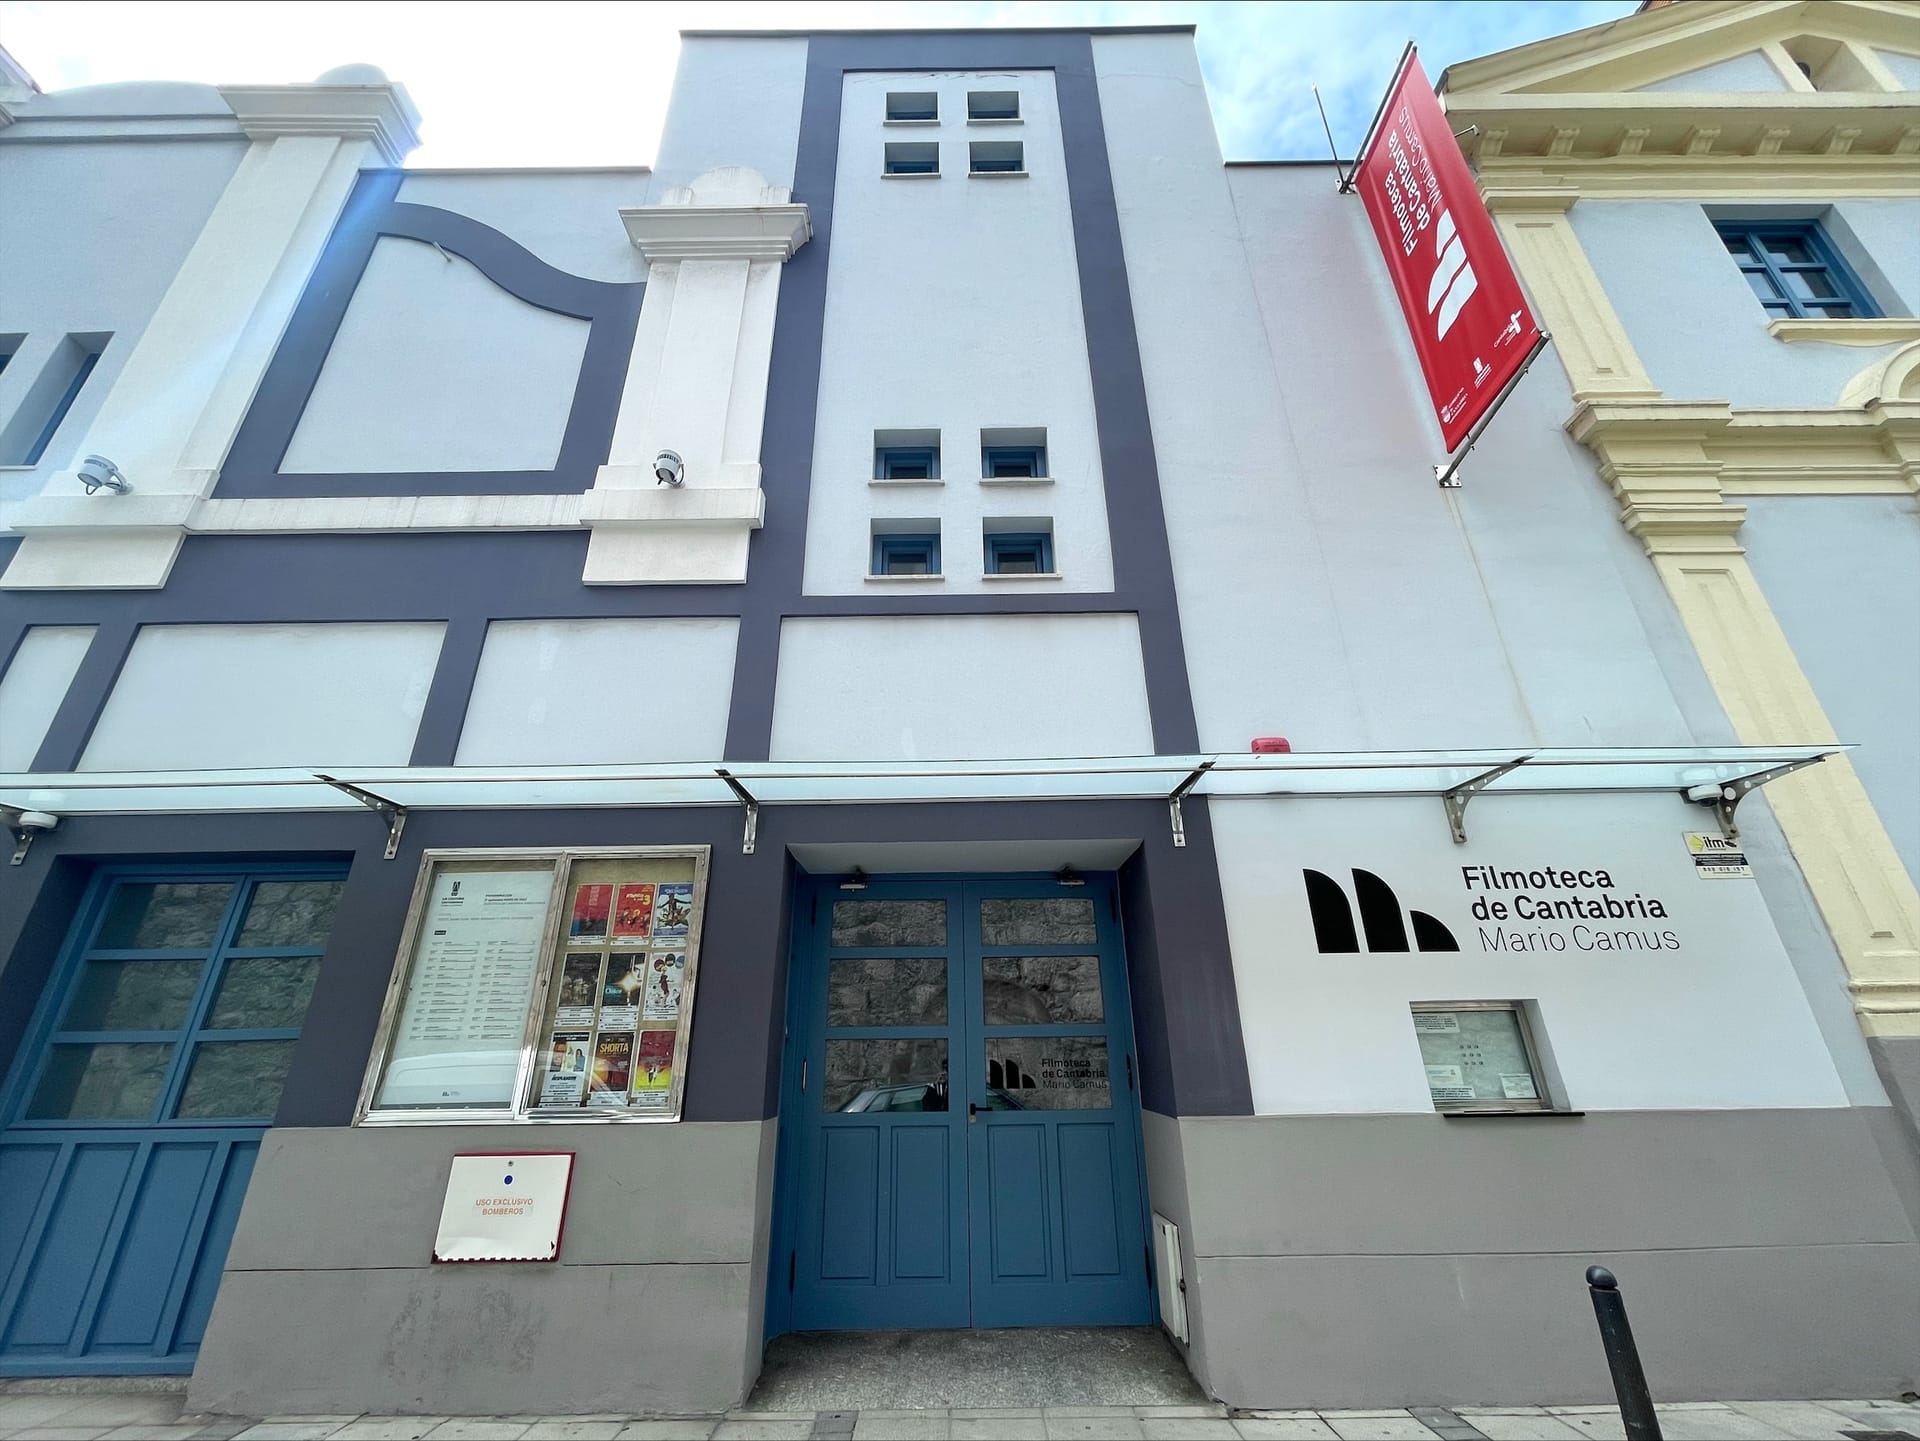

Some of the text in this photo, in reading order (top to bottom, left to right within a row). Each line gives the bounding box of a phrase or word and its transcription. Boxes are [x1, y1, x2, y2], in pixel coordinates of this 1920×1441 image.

[1399, 106, 1443, 214] Mario Camus
[1388, 129, 1430, 231] de Cantabria
[1385, 170, 1419, 257] Filmoteca
[1461, 865, 1615, 890] Filmoteca
[1471, 893, 1668, 921] de Cantabria
[1478, 925, 1680, 952] Mario Camus
[599, 1042, 629, 1054] SHORTA
[1041, 1058, 1091, 1068] Filmoteca
[1042, 1069, 1106, 1079] de Cantabria
[1042, 1079, 1108, 1089] Mario Camus
[475, 1198, 534, 1207] USO EXCLUSIVO
[481, 1207, 524, 1216] BOMBEROS
